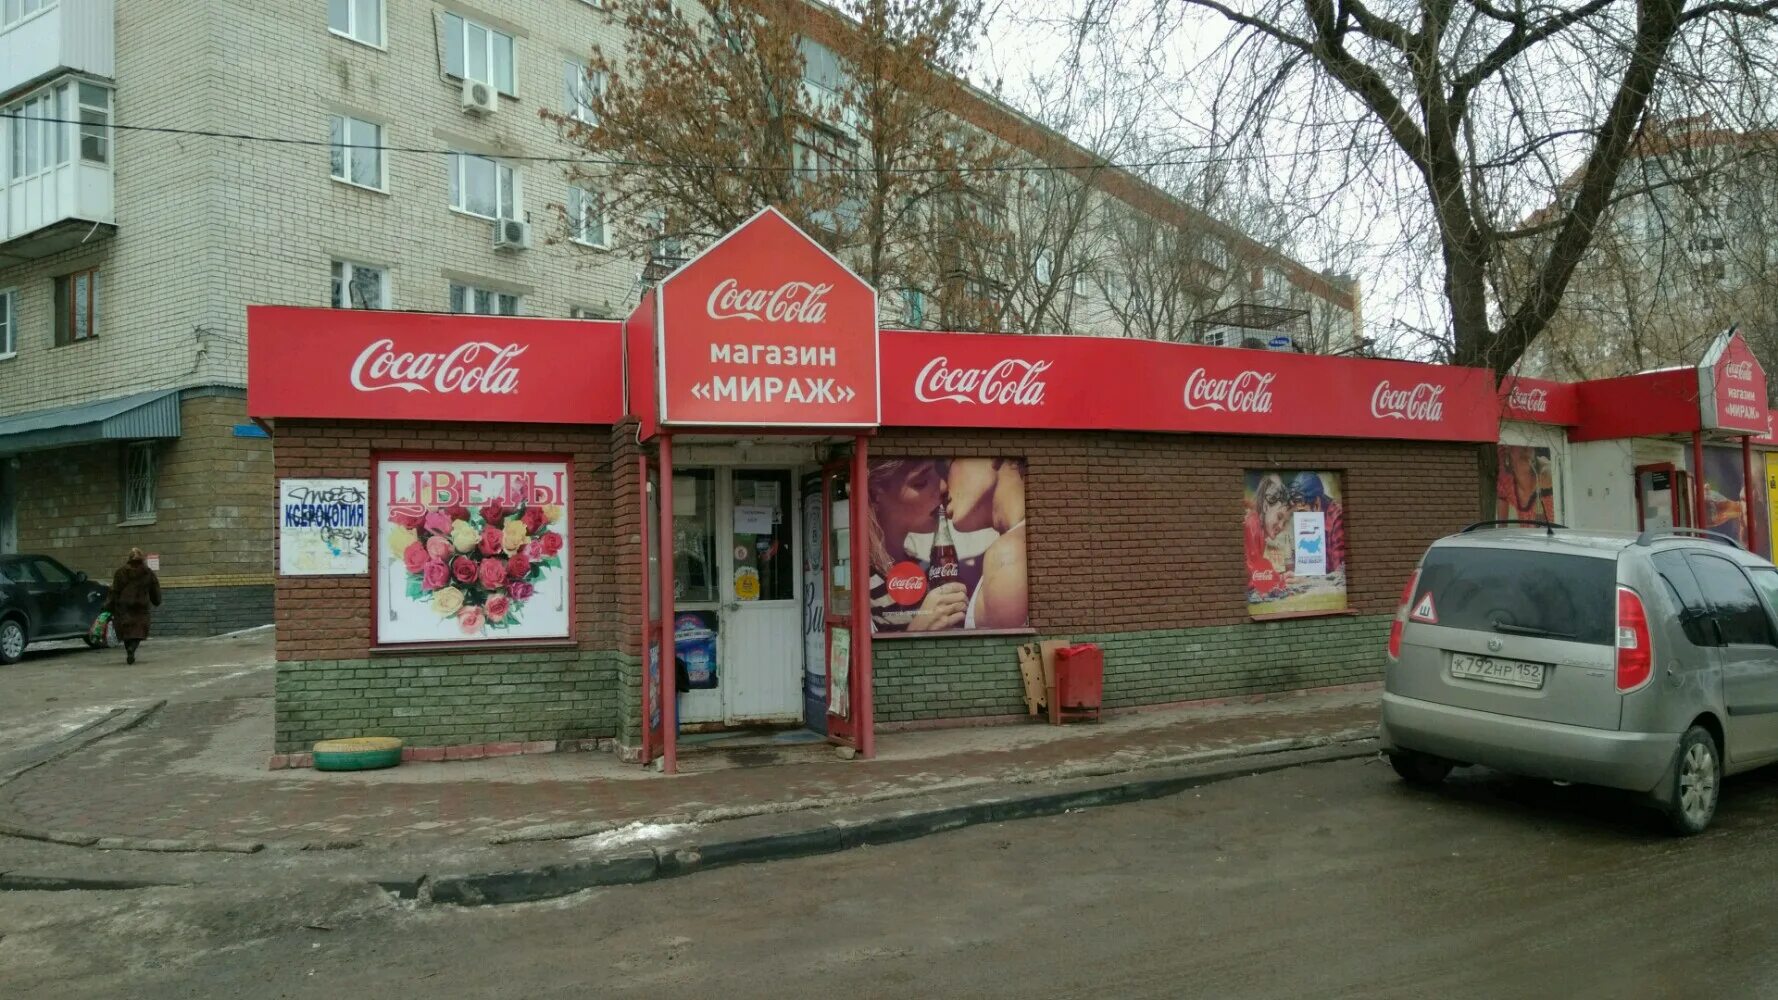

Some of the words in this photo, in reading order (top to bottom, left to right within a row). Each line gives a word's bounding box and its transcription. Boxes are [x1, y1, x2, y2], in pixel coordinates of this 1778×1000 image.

[707, 278, 834, 323] Coca-Cola
[350, 339, 529, 394] Coca-Cola
[710, 343, 836, 366] магазин
[691, 375, 856, 404] «МИРАЖ»
[914, 356, 1054, 406] Coca-Cola
[1183, 367, 1277, 413] Coca-Cola
[1371, 380, 1445, 421] Coca-Cola
[285, 504, 364, 527] КСЕРОКОПИЯ
[387, 471, 565, 518] ЦВЕТЫ
